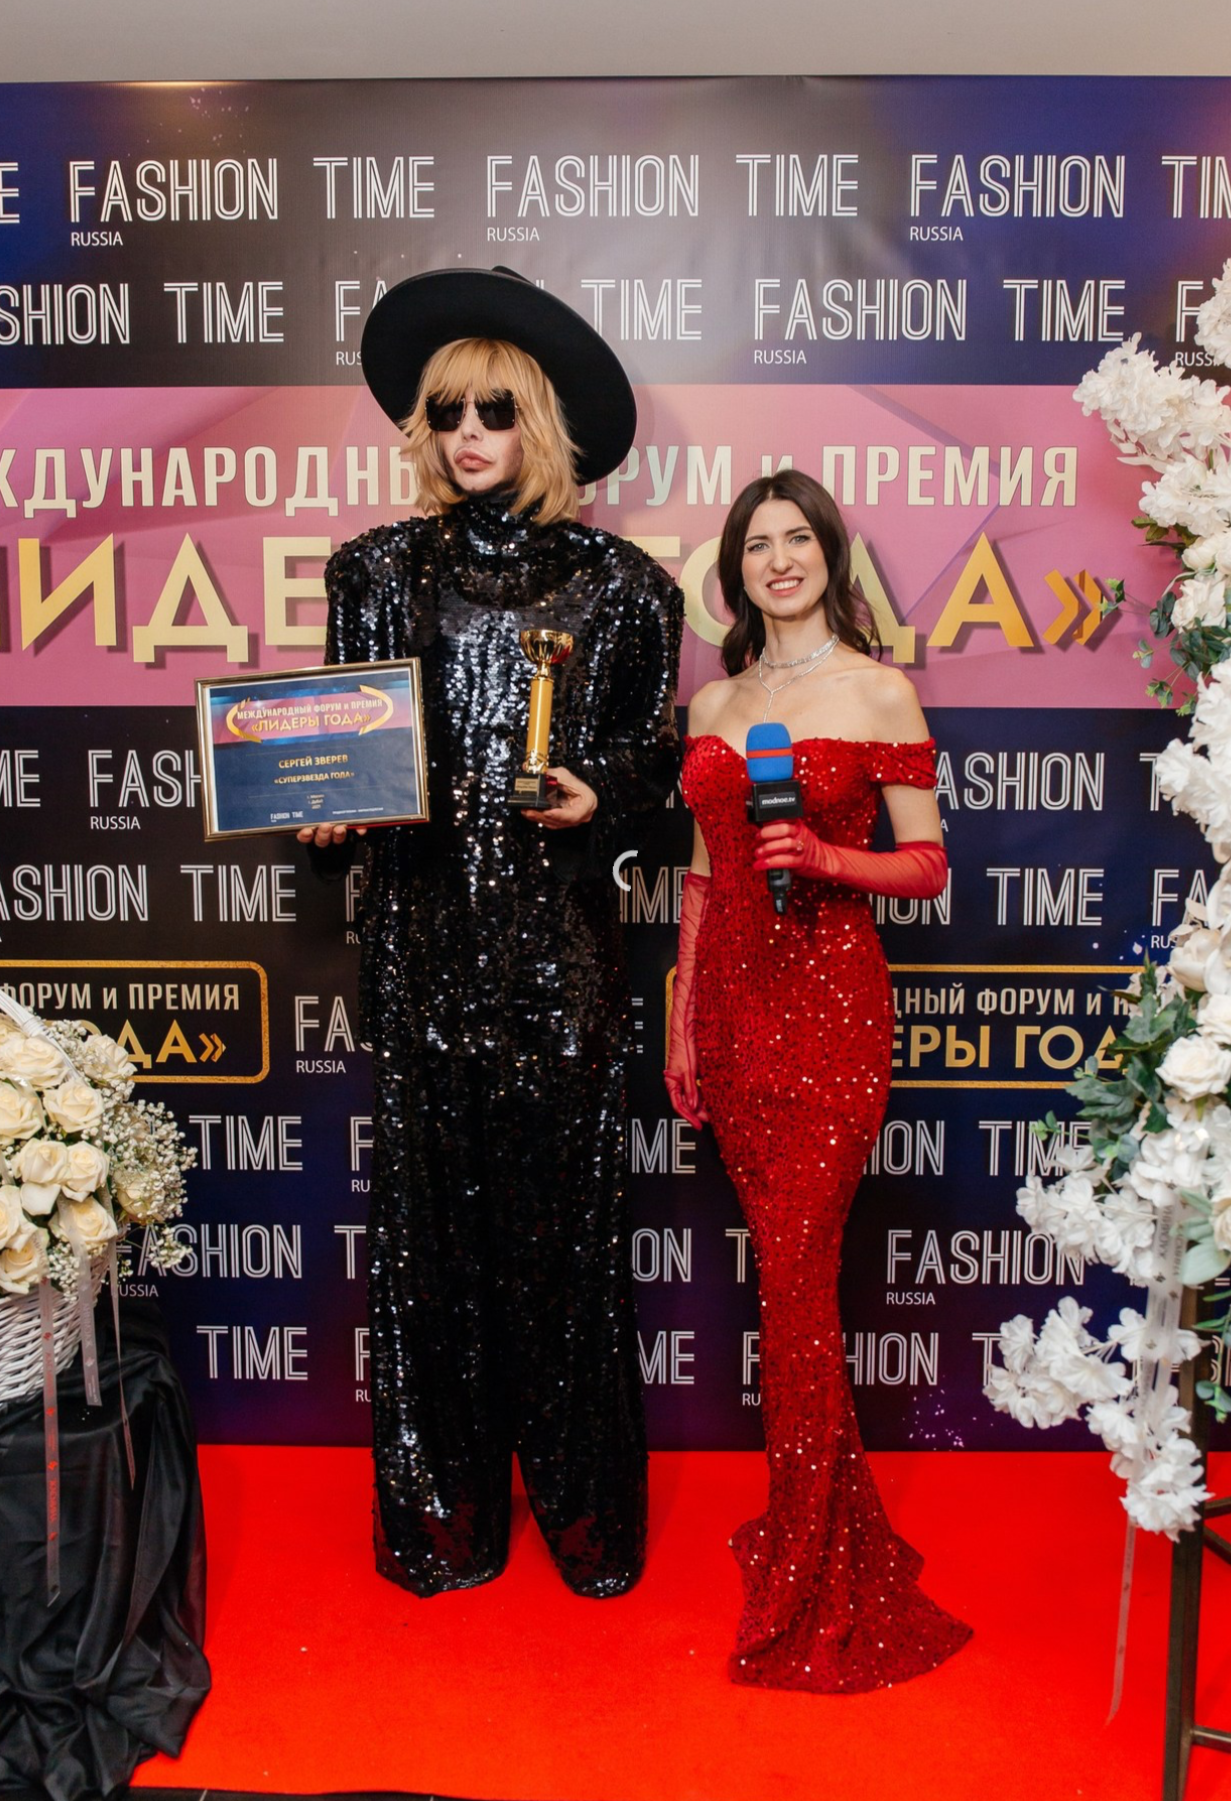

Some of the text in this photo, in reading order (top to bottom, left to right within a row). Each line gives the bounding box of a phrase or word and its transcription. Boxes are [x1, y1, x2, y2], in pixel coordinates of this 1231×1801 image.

[69, 157, 278, 222] FASHION
[313, 156, 435, 219] TIME
[487, 154, 700, 218] FASHION
[735, 154, 859, 217] TIME
[910, 154, 1125, 218] FASHION
[1161, 155, 1231, 219] TIM
[71, 231, 124, 246] RUSSIA
[487, 227, 540, 242] RUSSIA
[909, 226, 964, 241] RUSSIA
[0, 283, 130, 346] SHION
[163, 281, 285, 344] TIME
[580, 278, 702, 341] TIME
[754, 278, 967, 341] FASHION
[1002, 279, 1125, 342] TIME
[753, 349, 807, 365] RUSSIA
[822, 445, 1078, 507] ПРЕМИЯ
[237, 705, 313, 721] МЕЖДУНАРОДНЫЙ
[314, 702, 343, 713] ФОРУМ
[351, 699, 384, 710] ПРЕМИЯ
[278, 753, 349, 769] СЕРГЕЙ ЗВЕРЕВ
[934, 751, 1105, 811] ASHION
[90, 815, 141, 830] RUSSIA
[0, 864, 149, 922] SHION
[180, 864, 296, 922] TIME
[619, 866, 690, 923] IME
[986, 867, 1105, 926] TIME
[103, 987, 118, 1010] и
[129, 983, 240, 1010] ПРЕМИЯ
[976, 987, 1074, 1015] ФОРУМ
[1086, 993, 1101, 1015] и
[296, 1059, 347, 1074] RUSSIA
[188, 1115, 303, 1171] TIME
[887, 1229, 1085, 1286] FASHION
[117, 1284, 159, 1298] USSIA
[886, 1291, 936, 1305] RUSSIA
[196, 1325, 308, 1381] TIME
